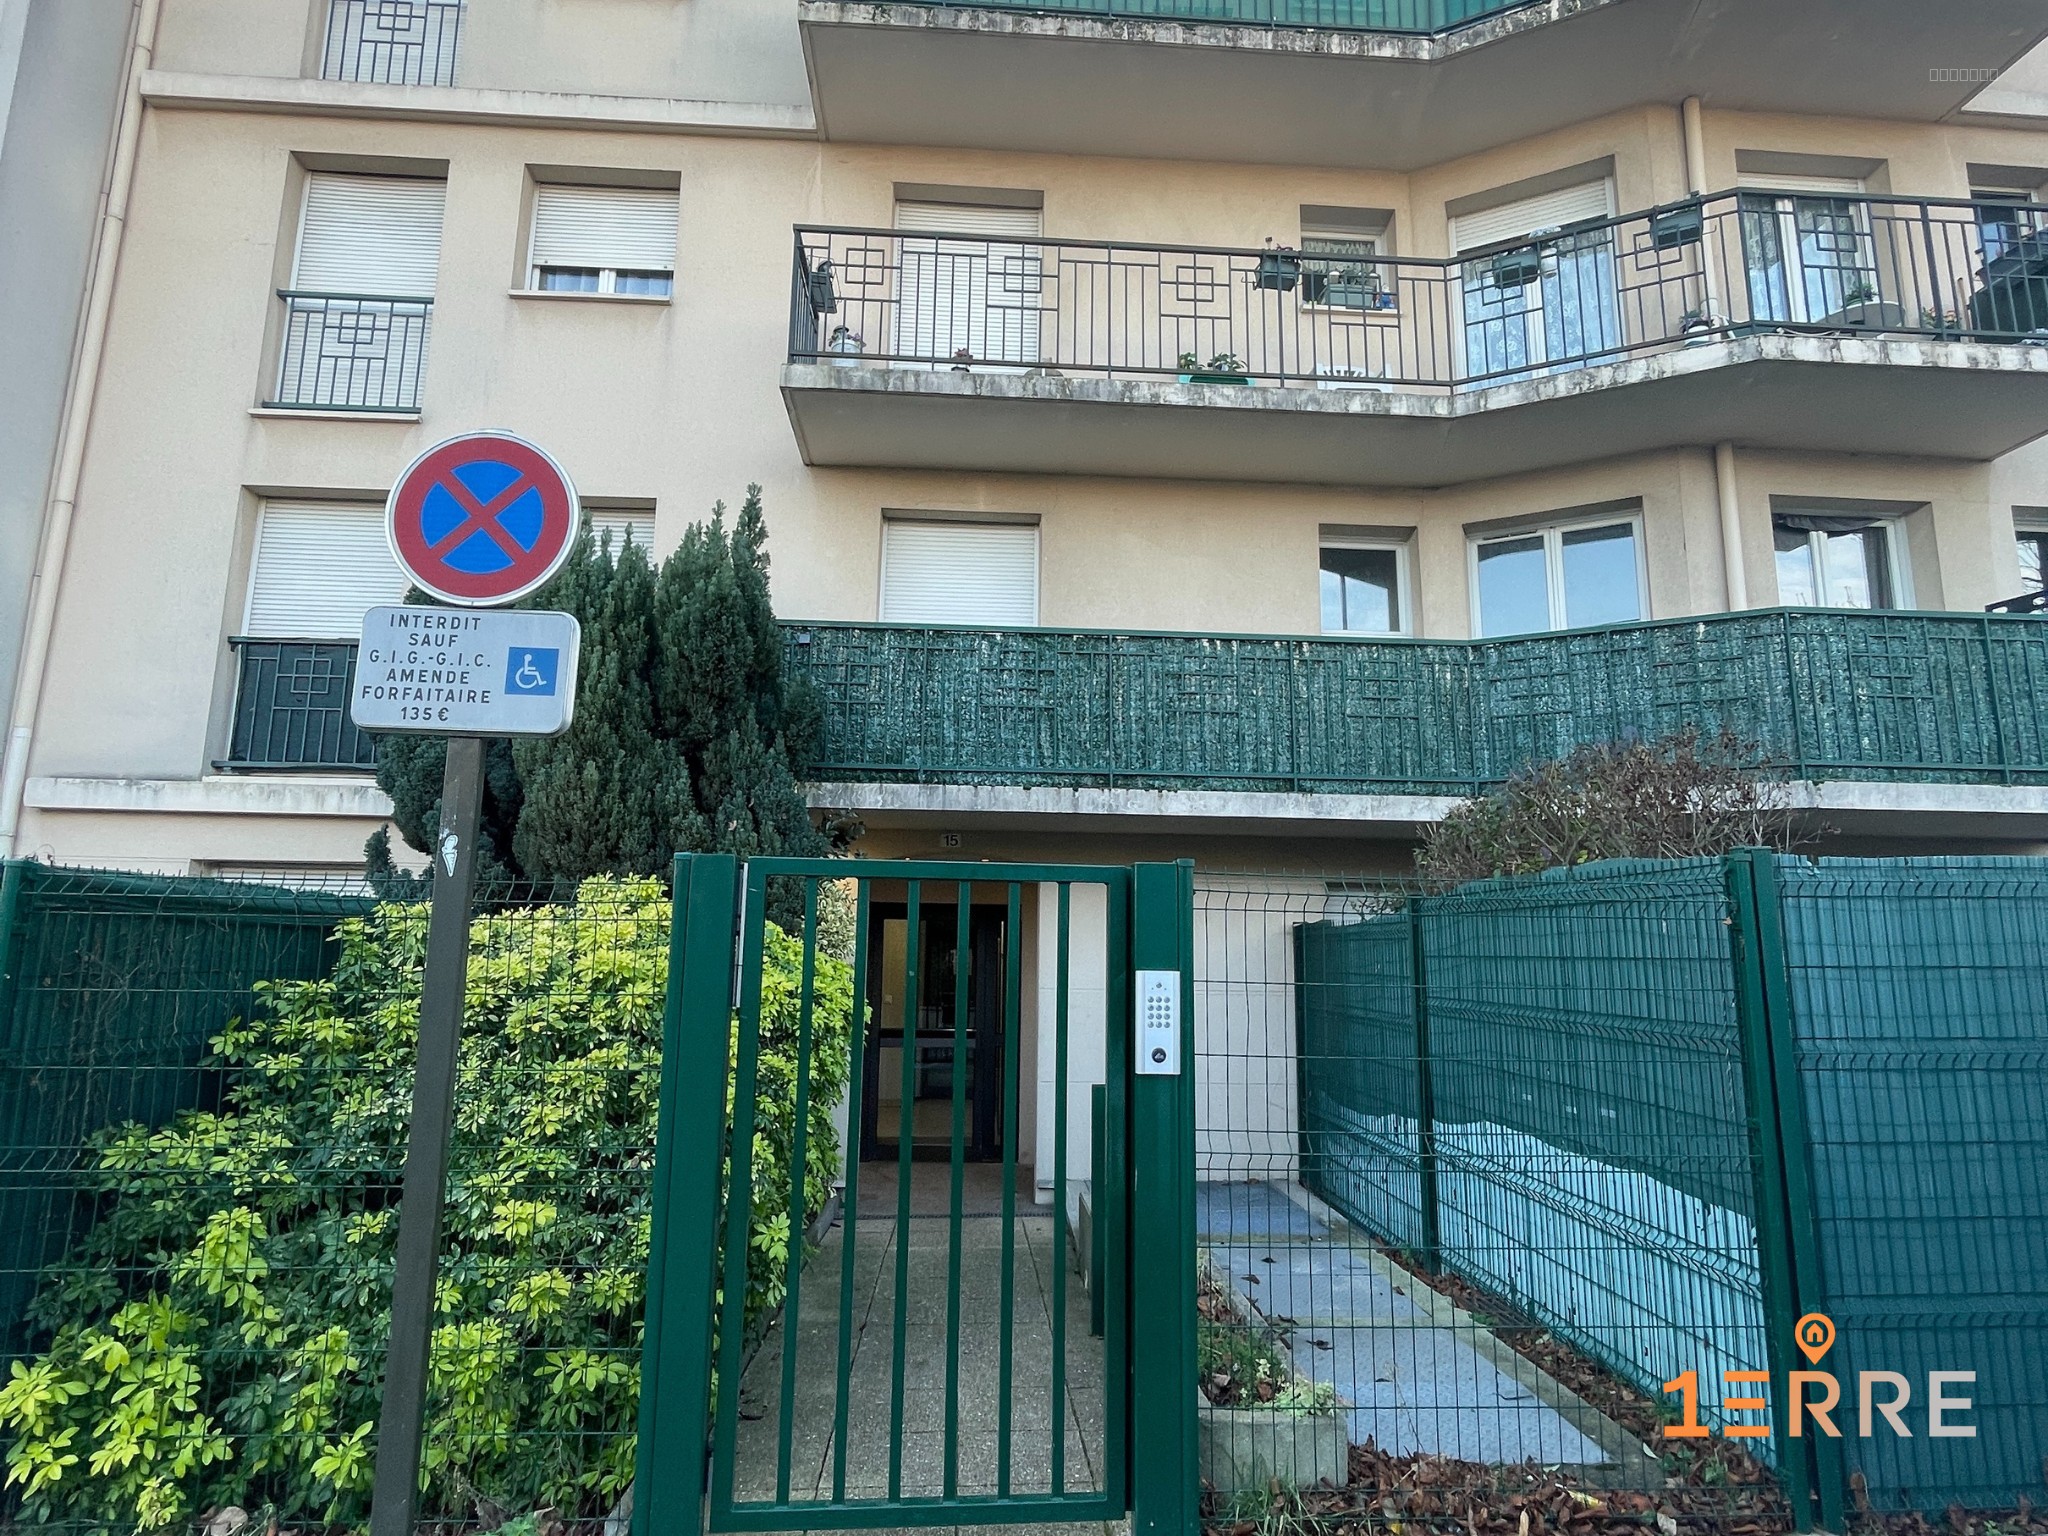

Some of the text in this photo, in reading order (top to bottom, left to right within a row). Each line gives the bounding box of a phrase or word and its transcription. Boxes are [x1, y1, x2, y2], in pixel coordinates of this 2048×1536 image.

[390, 614, 481, 630] INTERDIT
[408, 633, 459, 647] SAUF
[369, 649, 491, 668] G.I.G.-G.I.C.
[386, 668, 470, 684] AMENDE
[361, 685, 491, 704] FORFAITAIRE
[944, 834, 959, 847] 15
